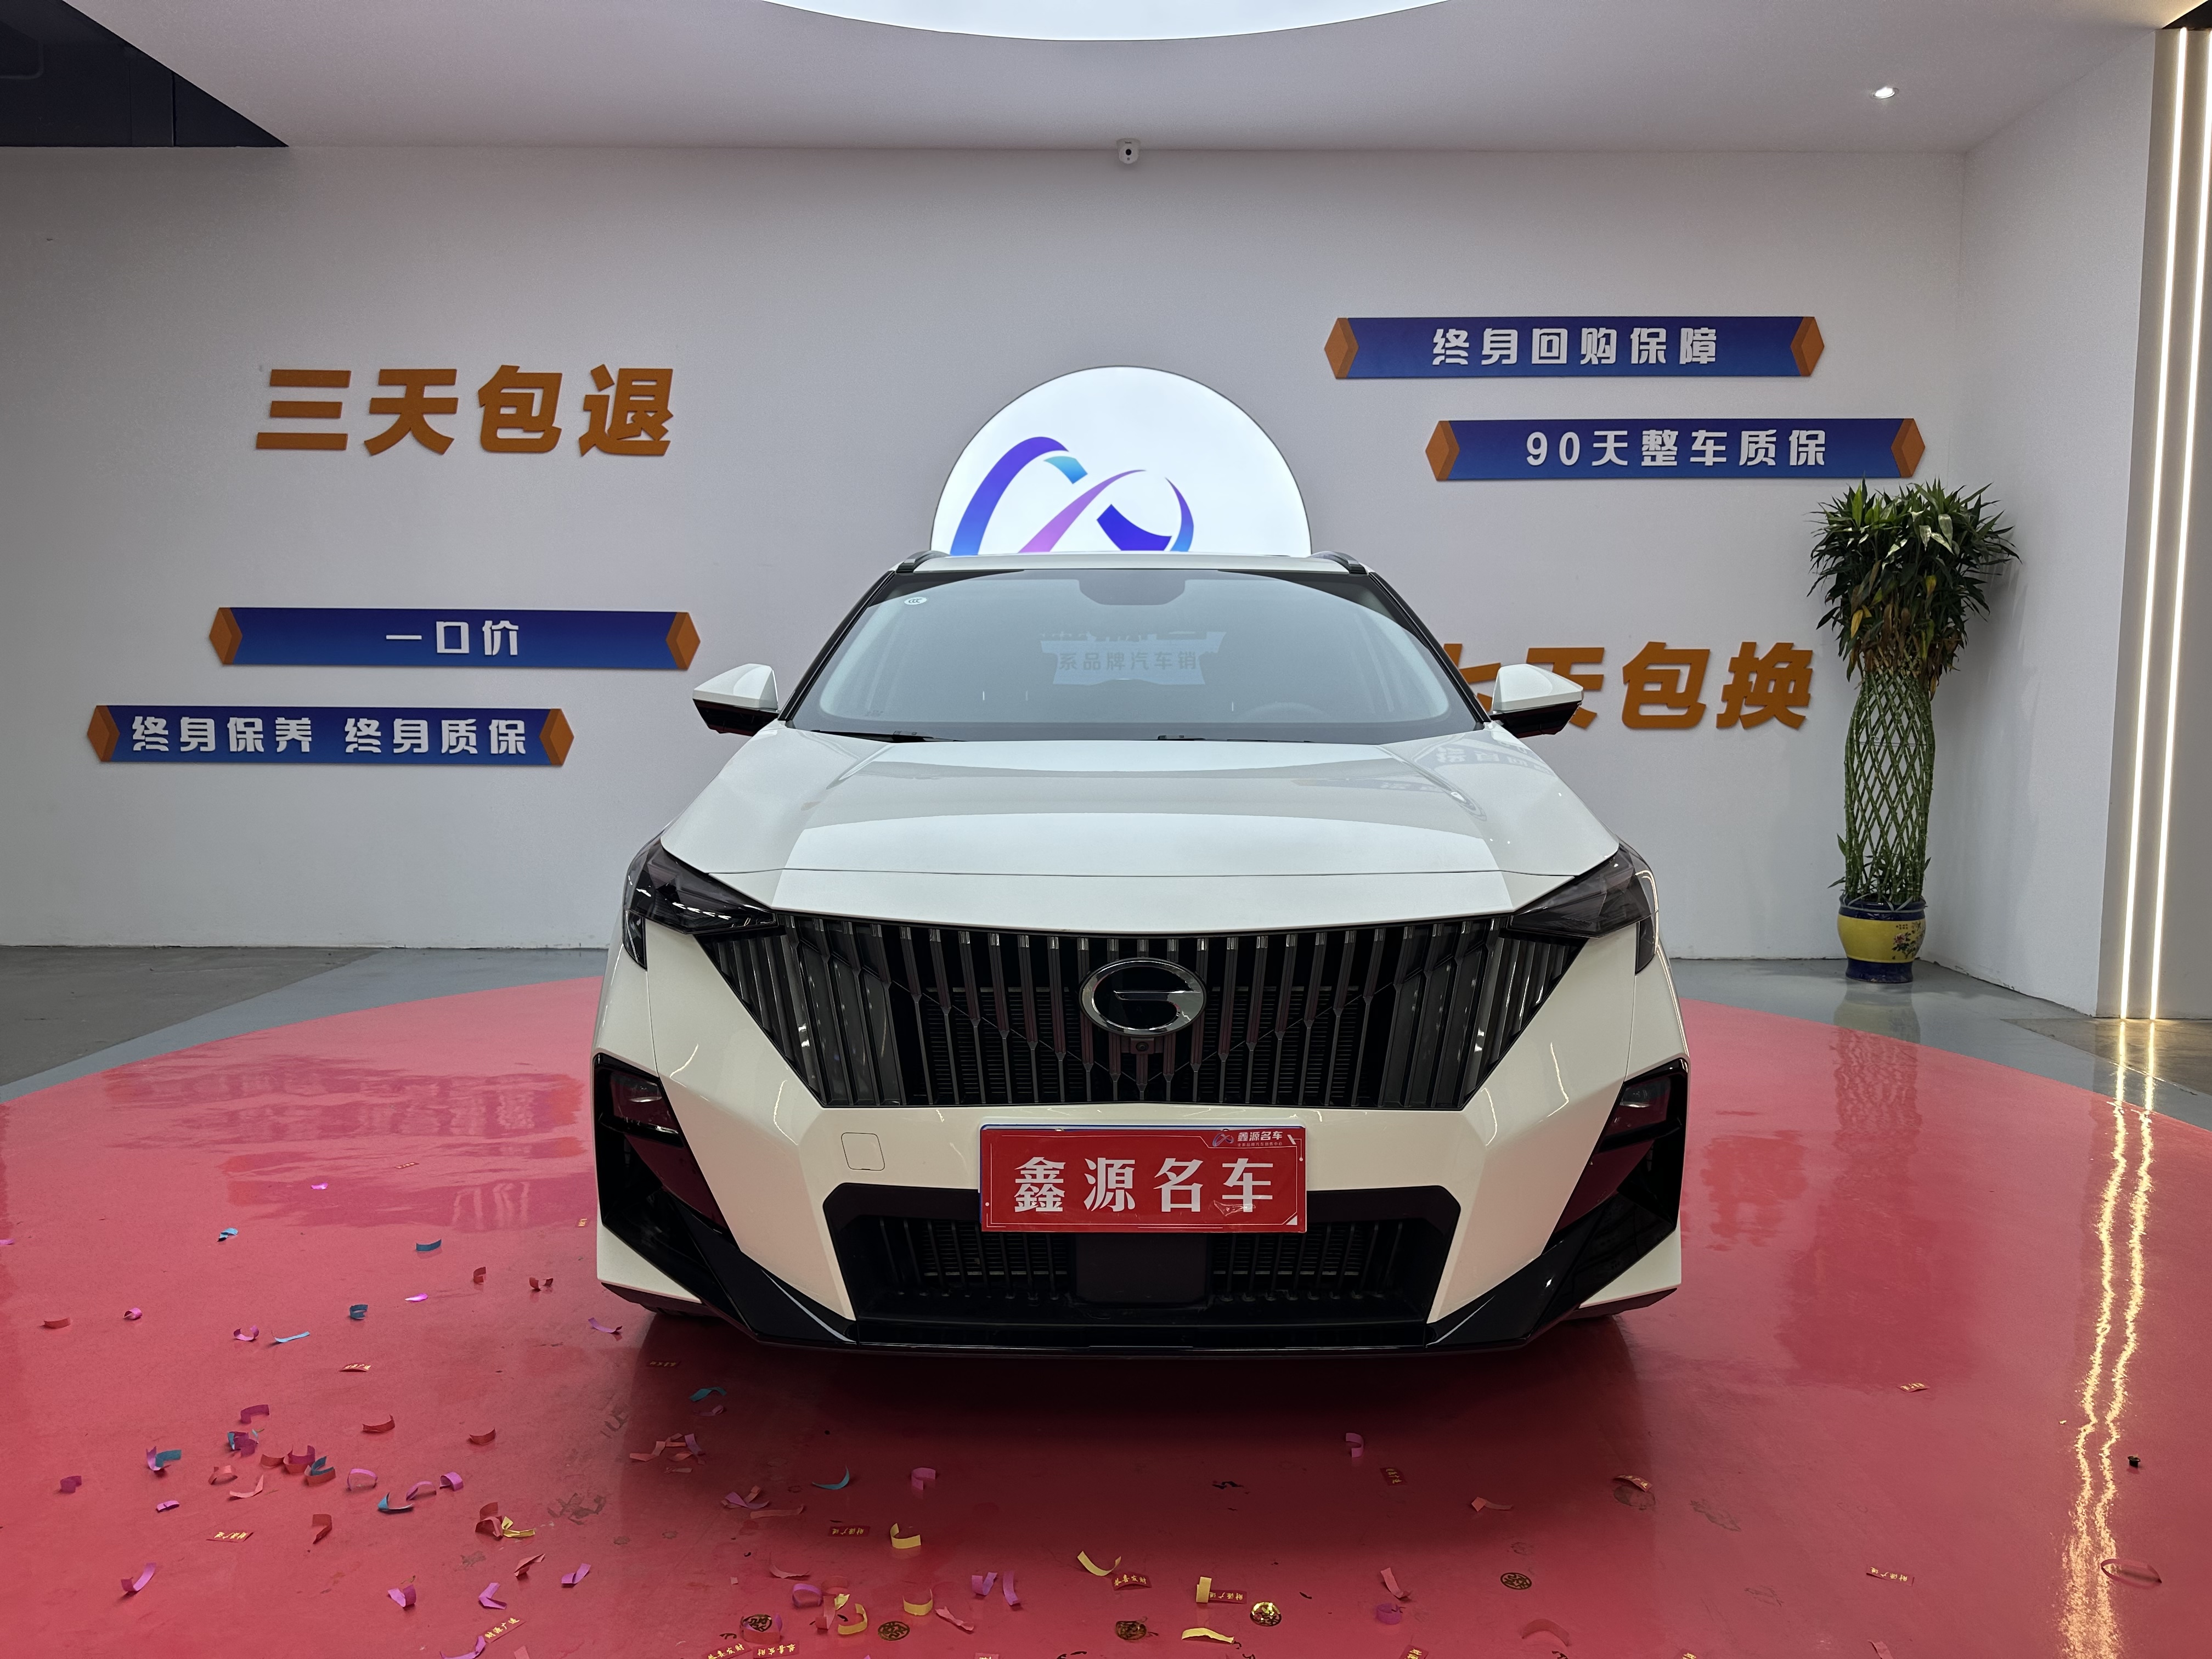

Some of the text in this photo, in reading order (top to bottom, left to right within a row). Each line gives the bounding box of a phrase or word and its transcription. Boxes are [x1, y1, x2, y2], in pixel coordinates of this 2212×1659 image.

[1432, 328, 1718, 366] 终身回购保障
[256, 364, 674, 456] 三天包退
[1527, 430, 1826, 467] 90天整车质保
[386, 620, 520, 657] 一口价
[132, 716, 527, 755] 终身保养 终身质保
[1237, 1131, 1283, 1142] 鑫源名车
[1014, 1156, 1274, 1213] 鑫源名车
